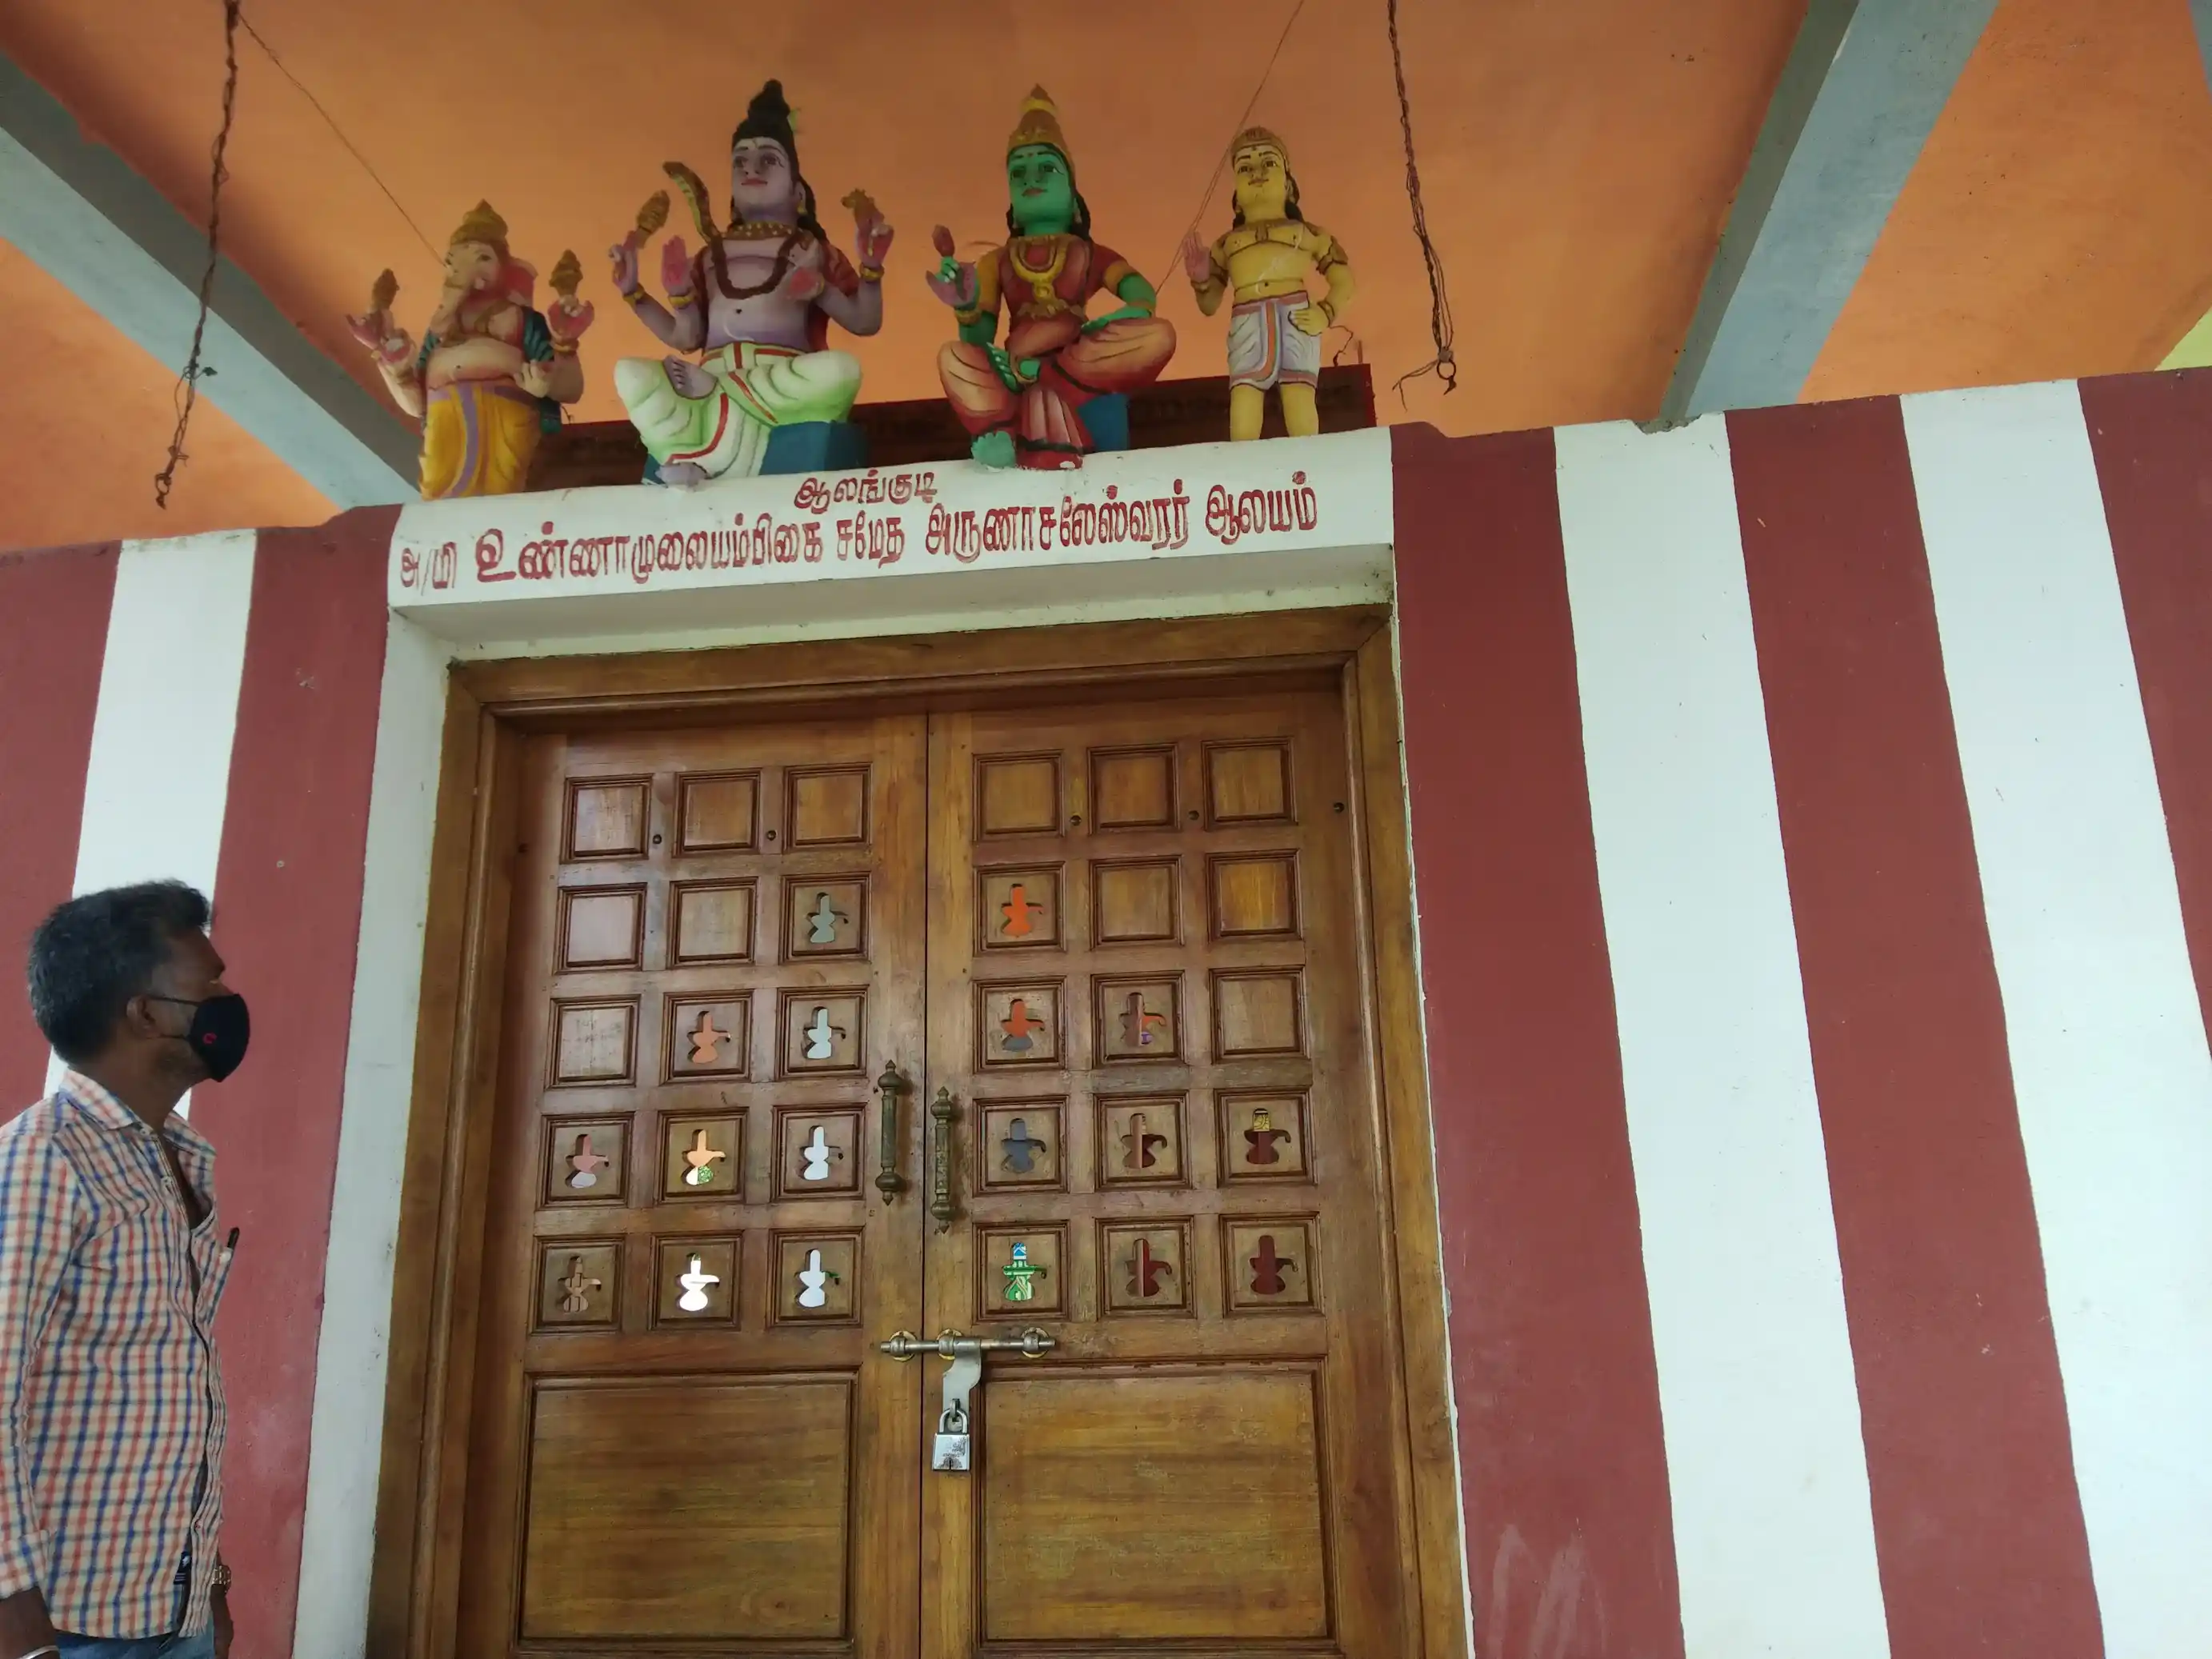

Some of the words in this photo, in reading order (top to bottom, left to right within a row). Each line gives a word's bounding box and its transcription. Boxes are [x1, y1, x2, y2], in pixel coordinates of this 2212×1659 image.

[476, 513, 825, 584] உண்ணாமுலையம்பிகை
[837, 510, 905, 568] சமேத
[926, 478, 1190, 563] அருணாசலேஸ்வரர்
[1205, 470, 1318, 546] ஆலயம்
[794, 467, 938, 514] ஆலங்குடி
